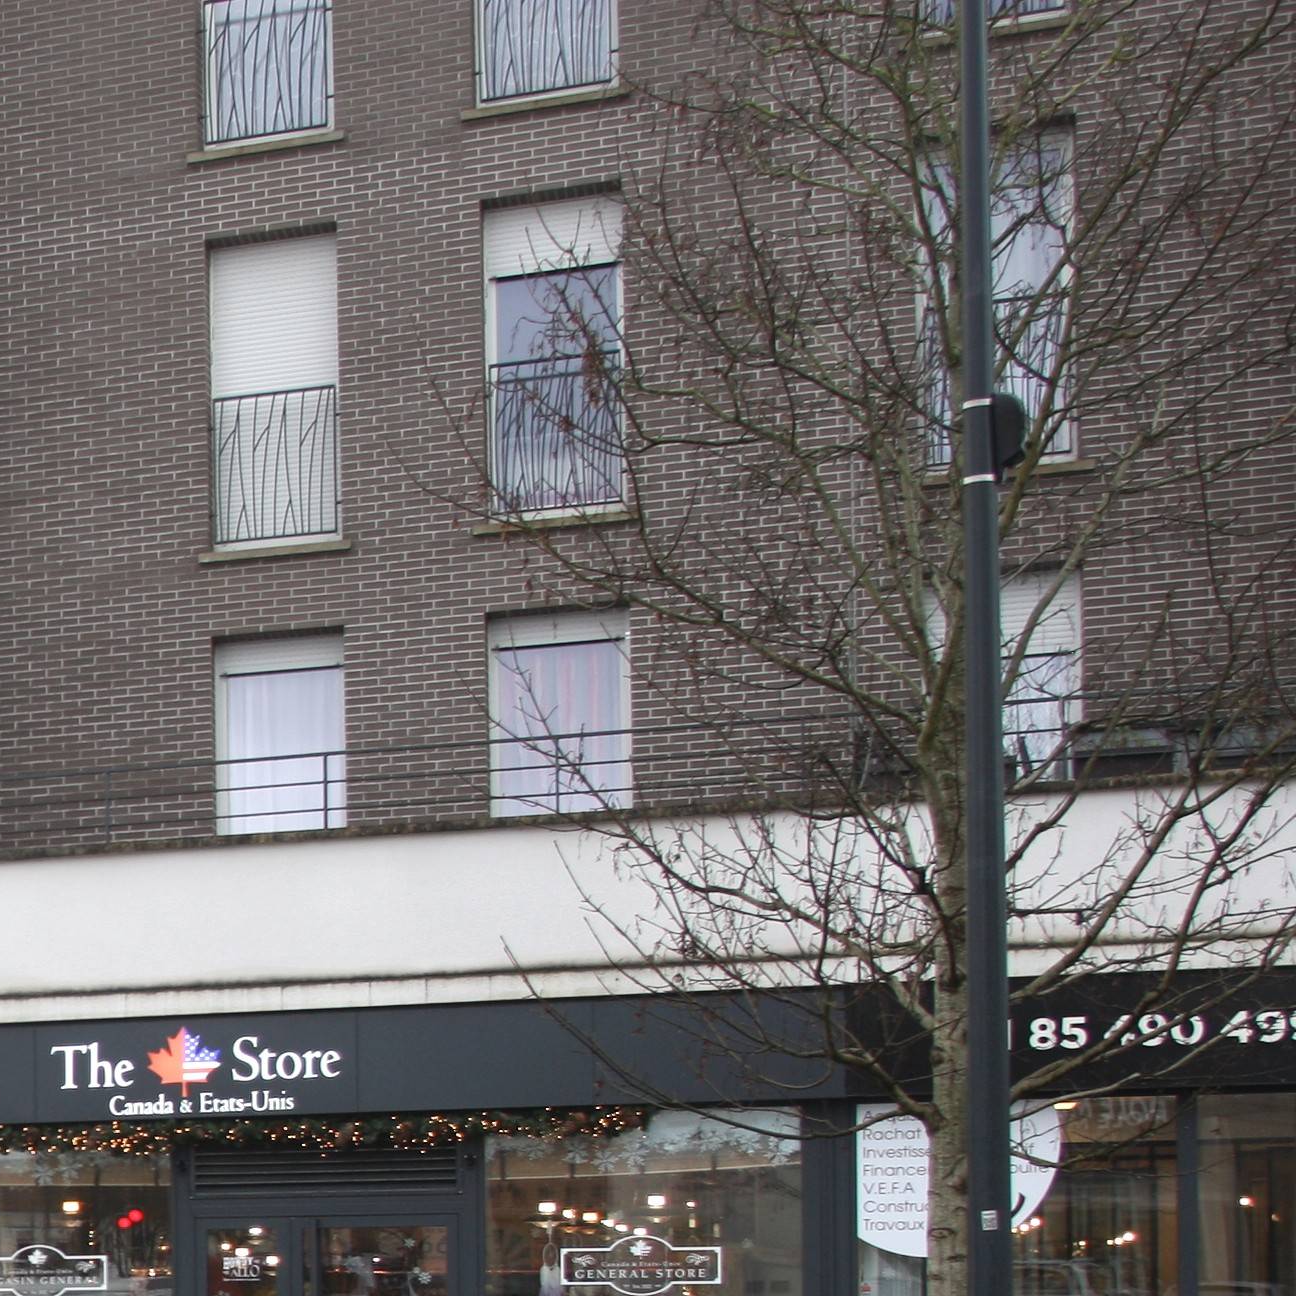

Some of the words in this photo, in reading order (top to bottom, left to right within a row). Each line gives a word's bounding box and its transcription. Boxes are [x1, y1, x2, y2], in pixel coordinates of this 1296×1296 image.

[1028, 1015, 1088, 1050] 85
[1220, 1009, 1296, 1044] 49
[50, 1041, 135, 1091] The
[231, 1035, 343, 1082] Store
[109, 1093, 174, 1116] Canada
[179, 1100, 193, 1114] &
[199, 1090, 295, 1113] Etats-Unis
[863, 1127, 922, 1140] Rachat
[862, 1182, 916, 1195] V.E.F.A
[863, 1218, 925, 1231] Travaux
[574, 1268, 649, 1280] GENERAL
[655, 1268, 706, 1279] STORE
